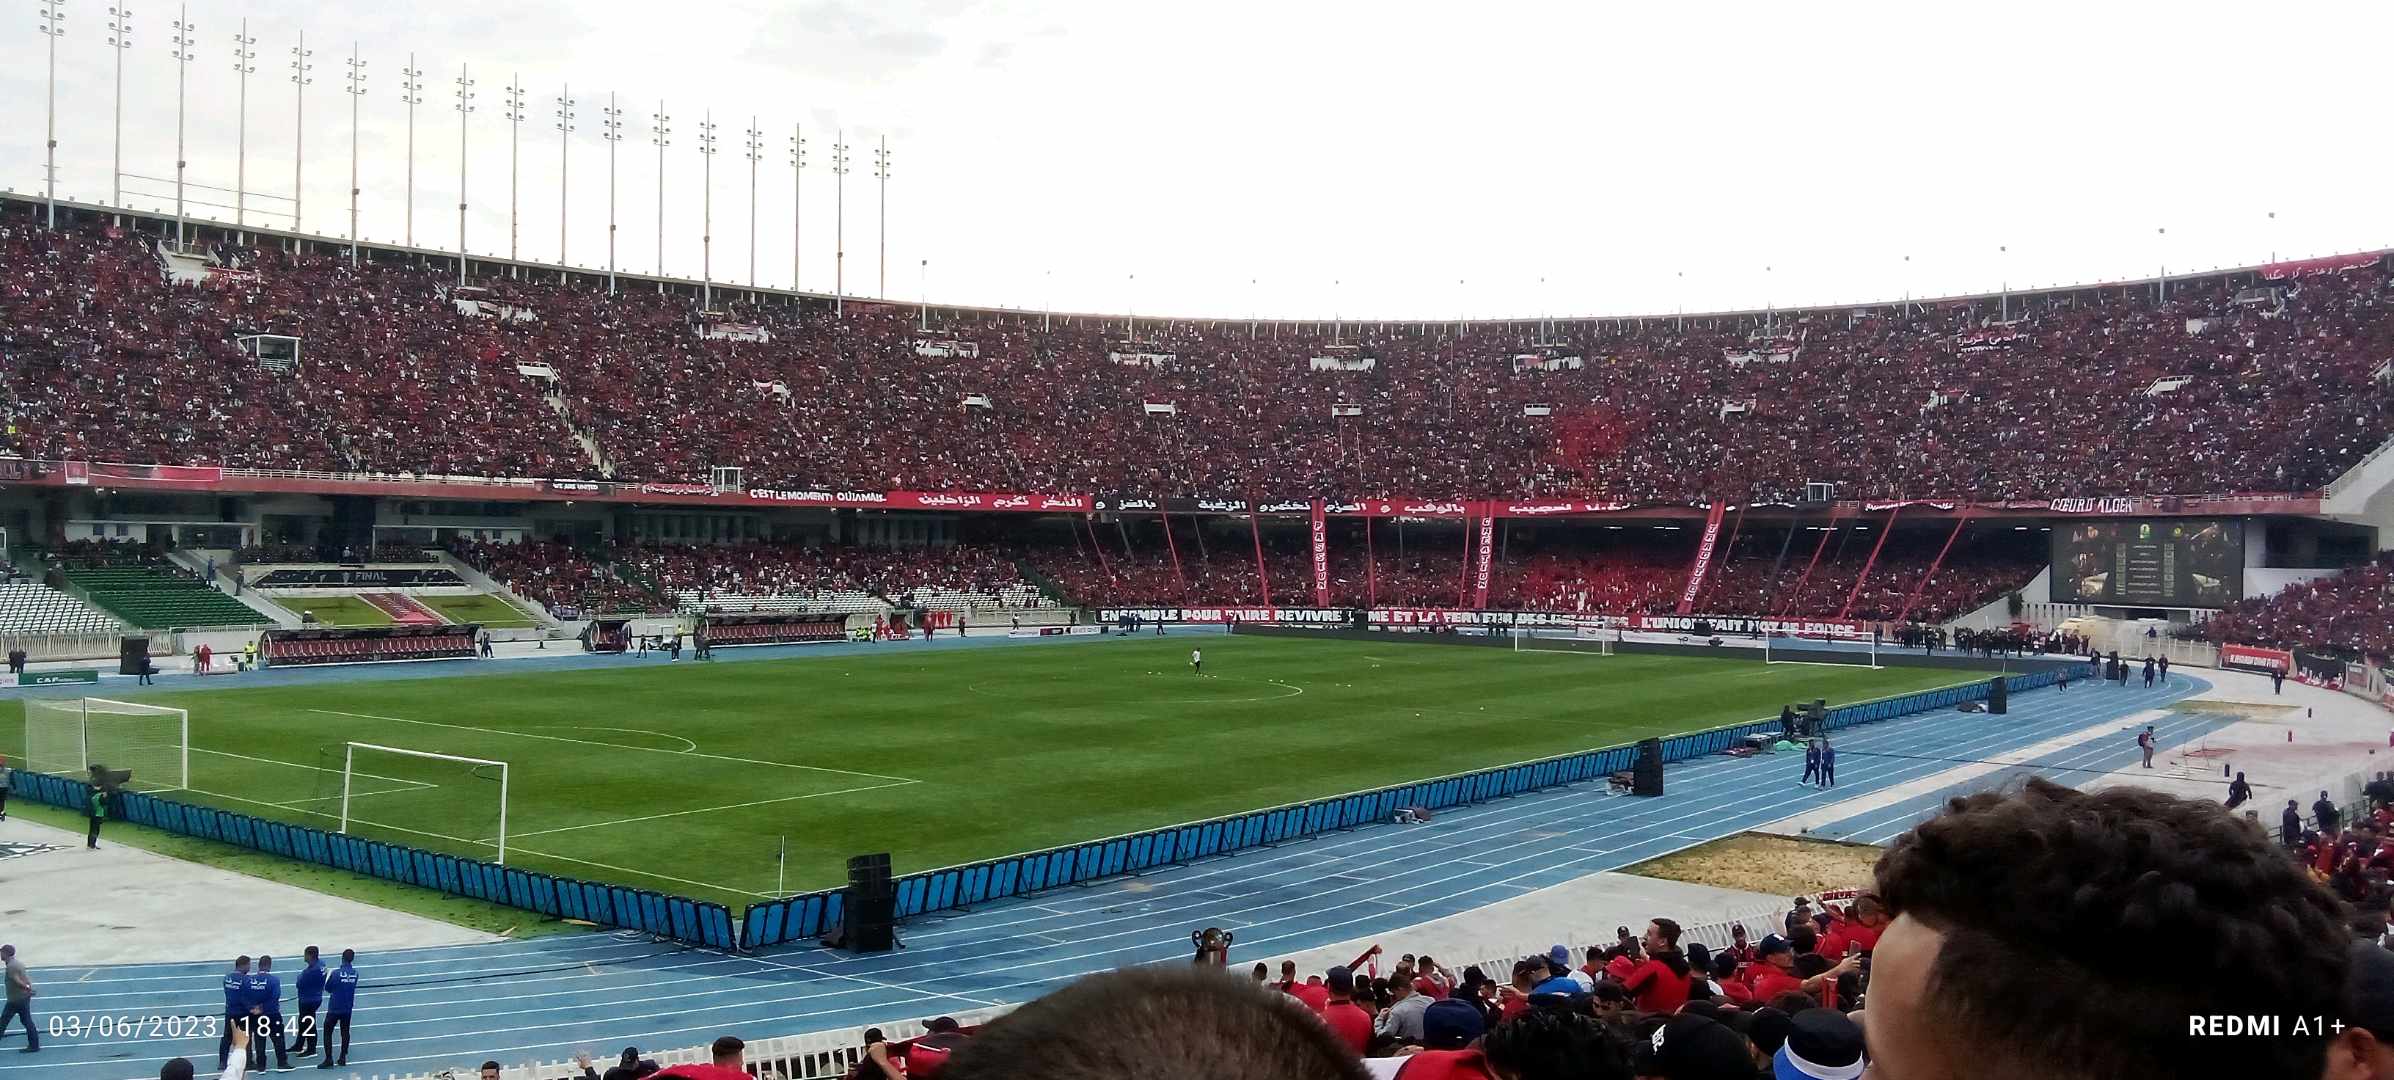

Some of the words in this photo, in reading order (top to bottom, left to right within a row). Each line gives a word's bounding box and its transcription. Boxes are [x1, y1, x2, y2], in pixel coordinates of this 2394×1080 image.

[355, 571, 387, 582] FINAL
[1181, 610, 1222, 621] POUR
[1275, 610, 1343, 621] REVIVRE
[1393, 612, 1414, 622] ET
